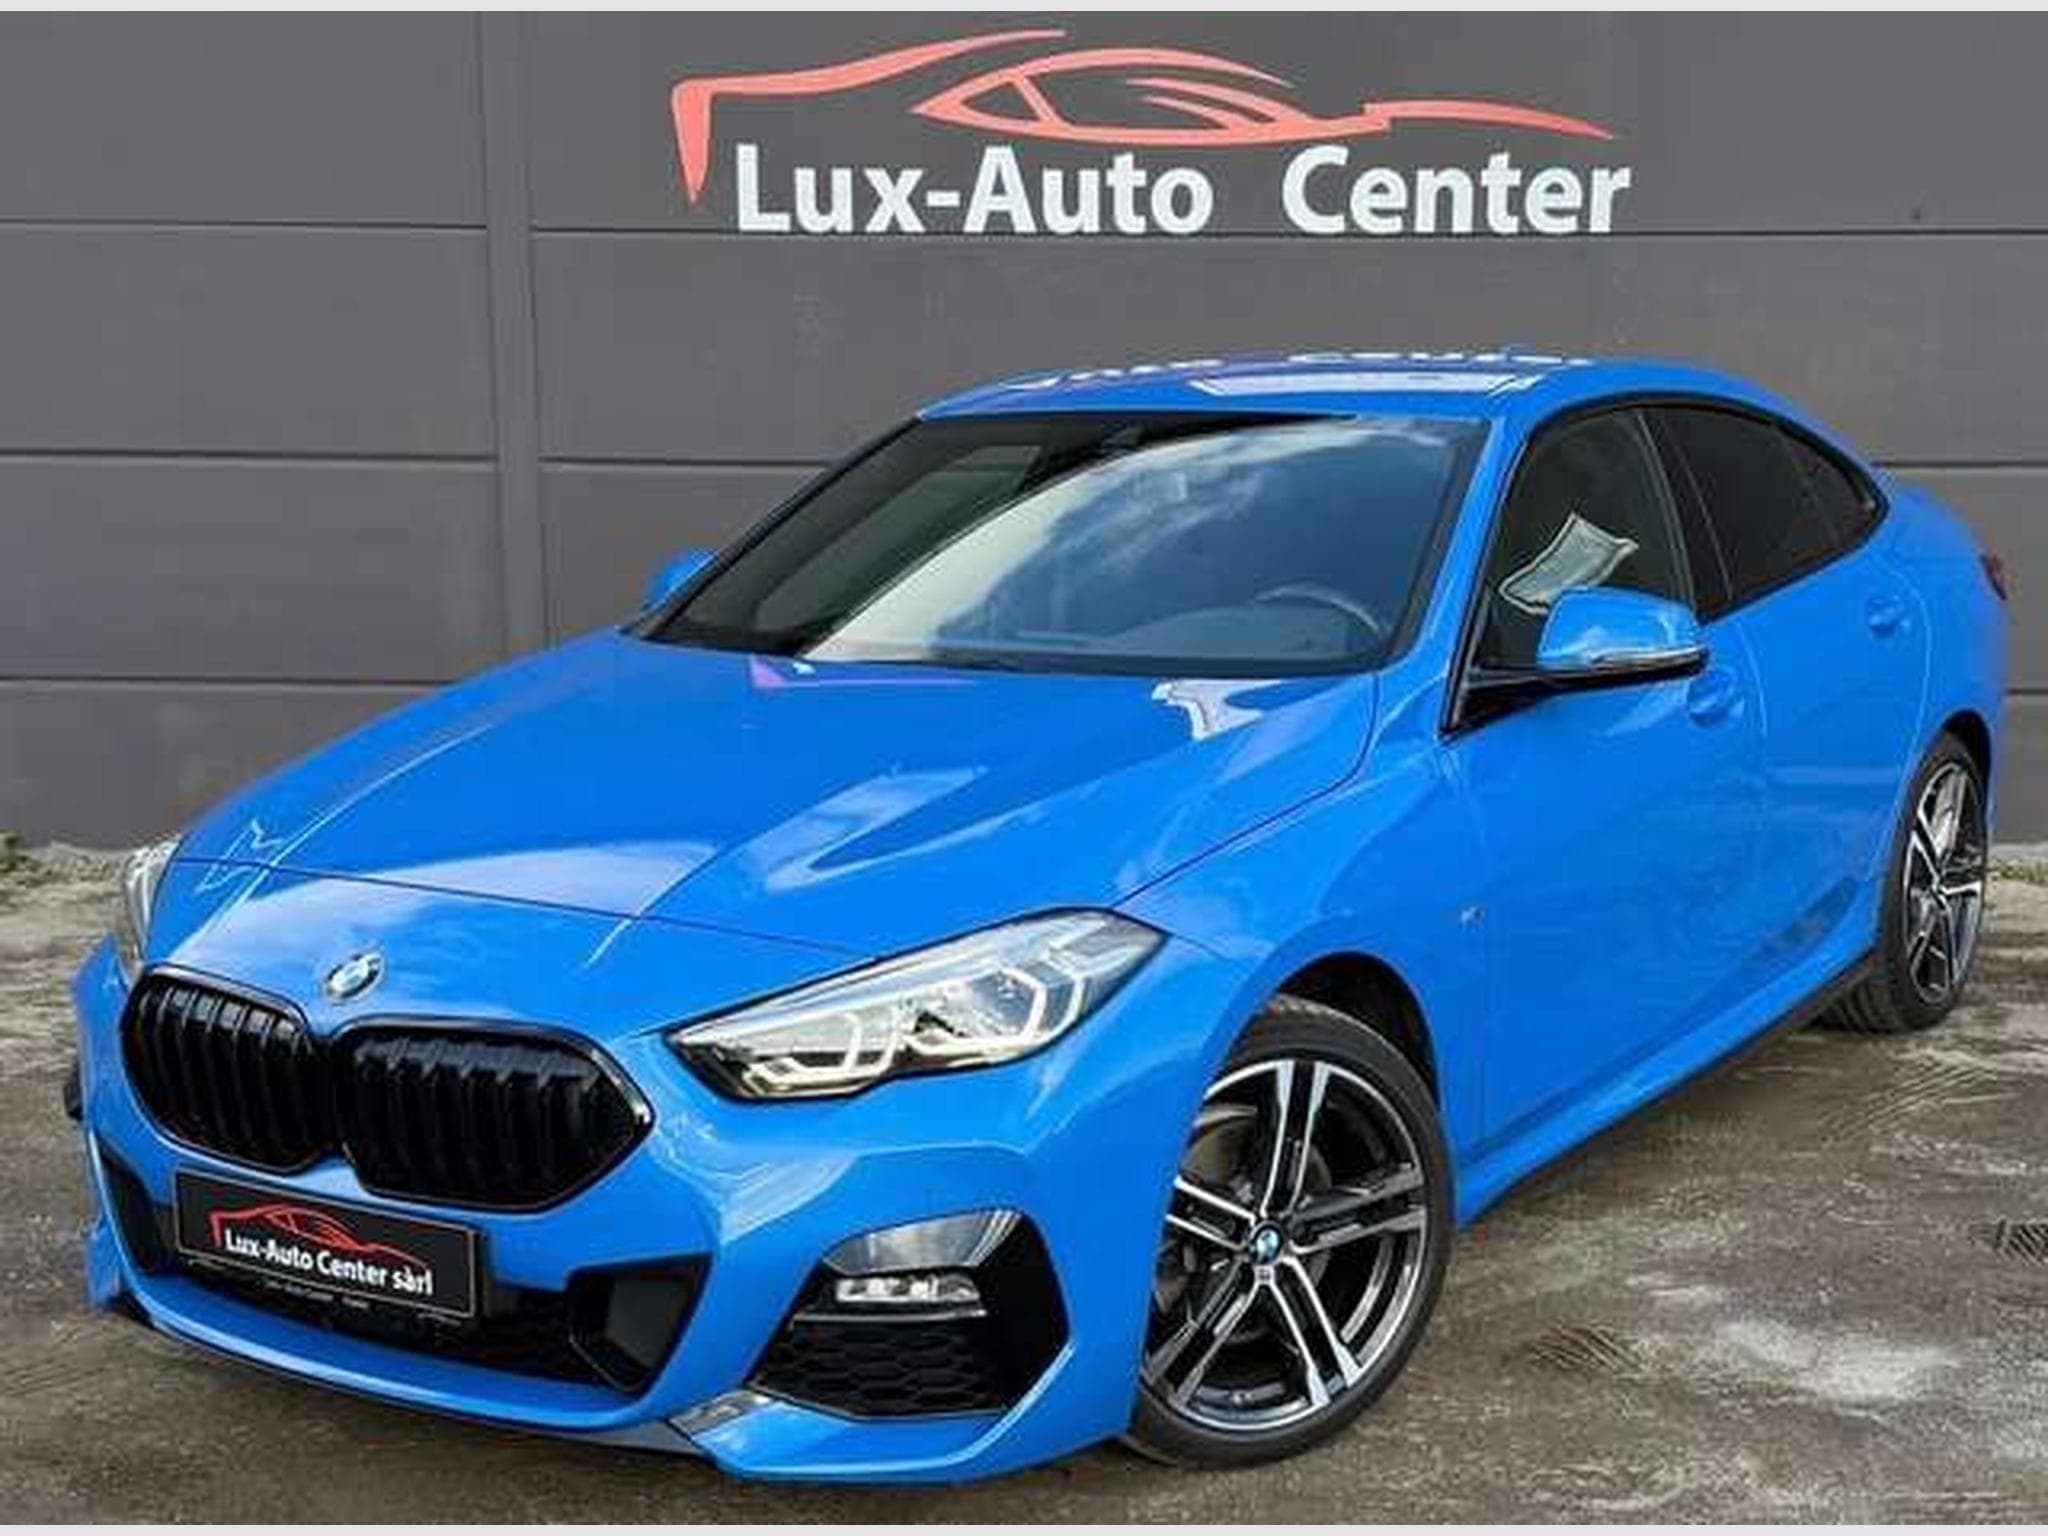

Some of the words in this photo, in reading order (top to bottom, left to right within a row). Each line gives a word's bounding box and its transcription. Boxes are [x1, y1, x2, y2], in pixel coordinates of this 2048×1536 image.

[736, 143, 1214, 236] Lux-Auto
[1281, 144, 1632, 237] Center
[225, 1227, 314, 1271] Lux-Auto
[316, 1251, 387, 1287] Center
